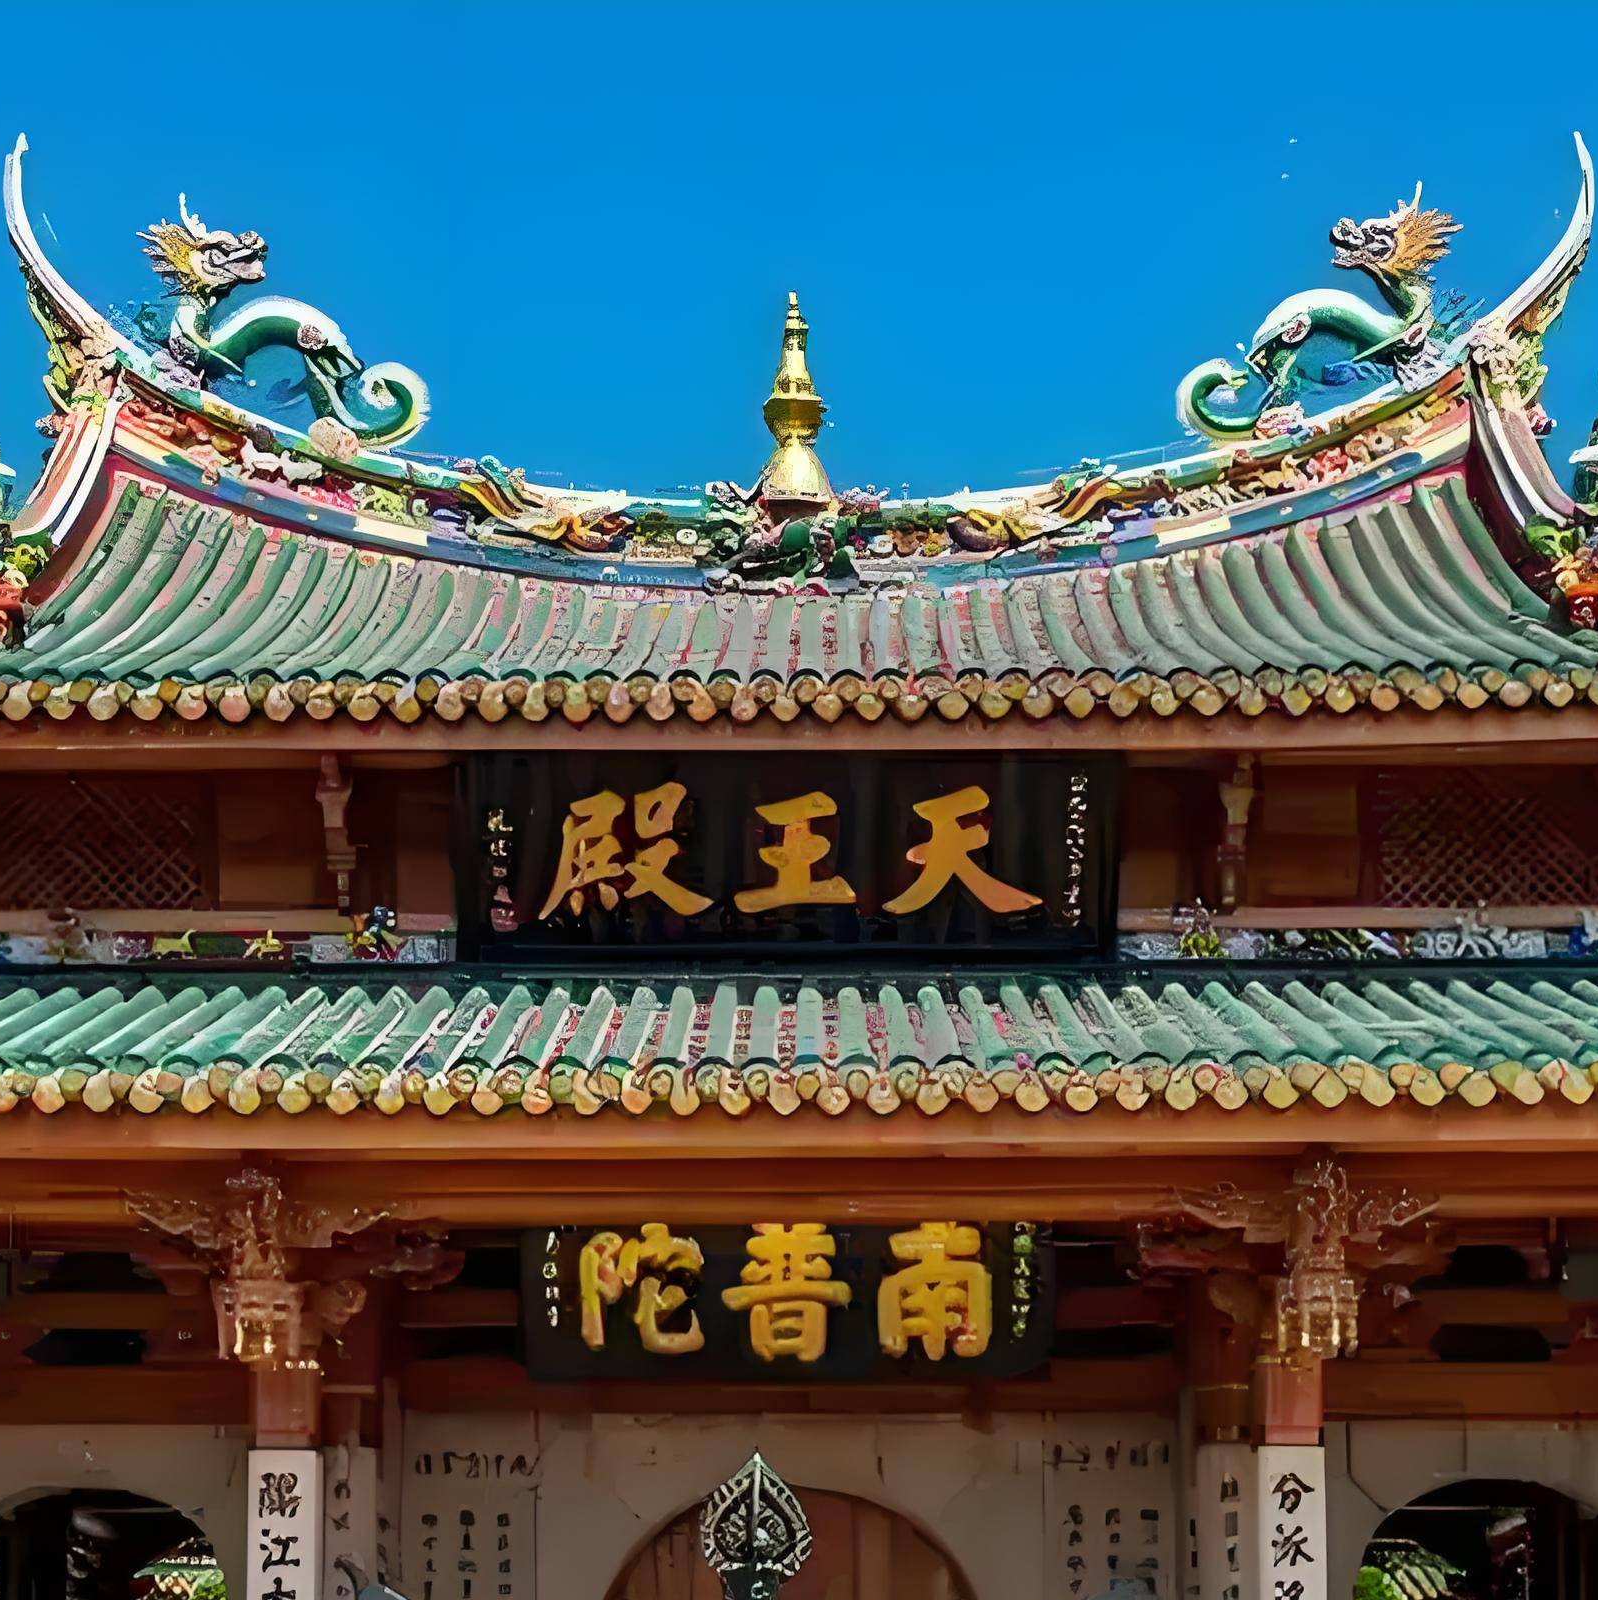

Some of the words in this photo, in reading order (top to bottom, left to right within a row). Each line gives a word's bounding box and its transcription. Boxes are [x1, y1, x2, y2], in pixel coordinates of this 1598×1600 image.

[539, 780, 1044, 920] 天王殿
[579, 1221, 993, 1363] 南普陀
